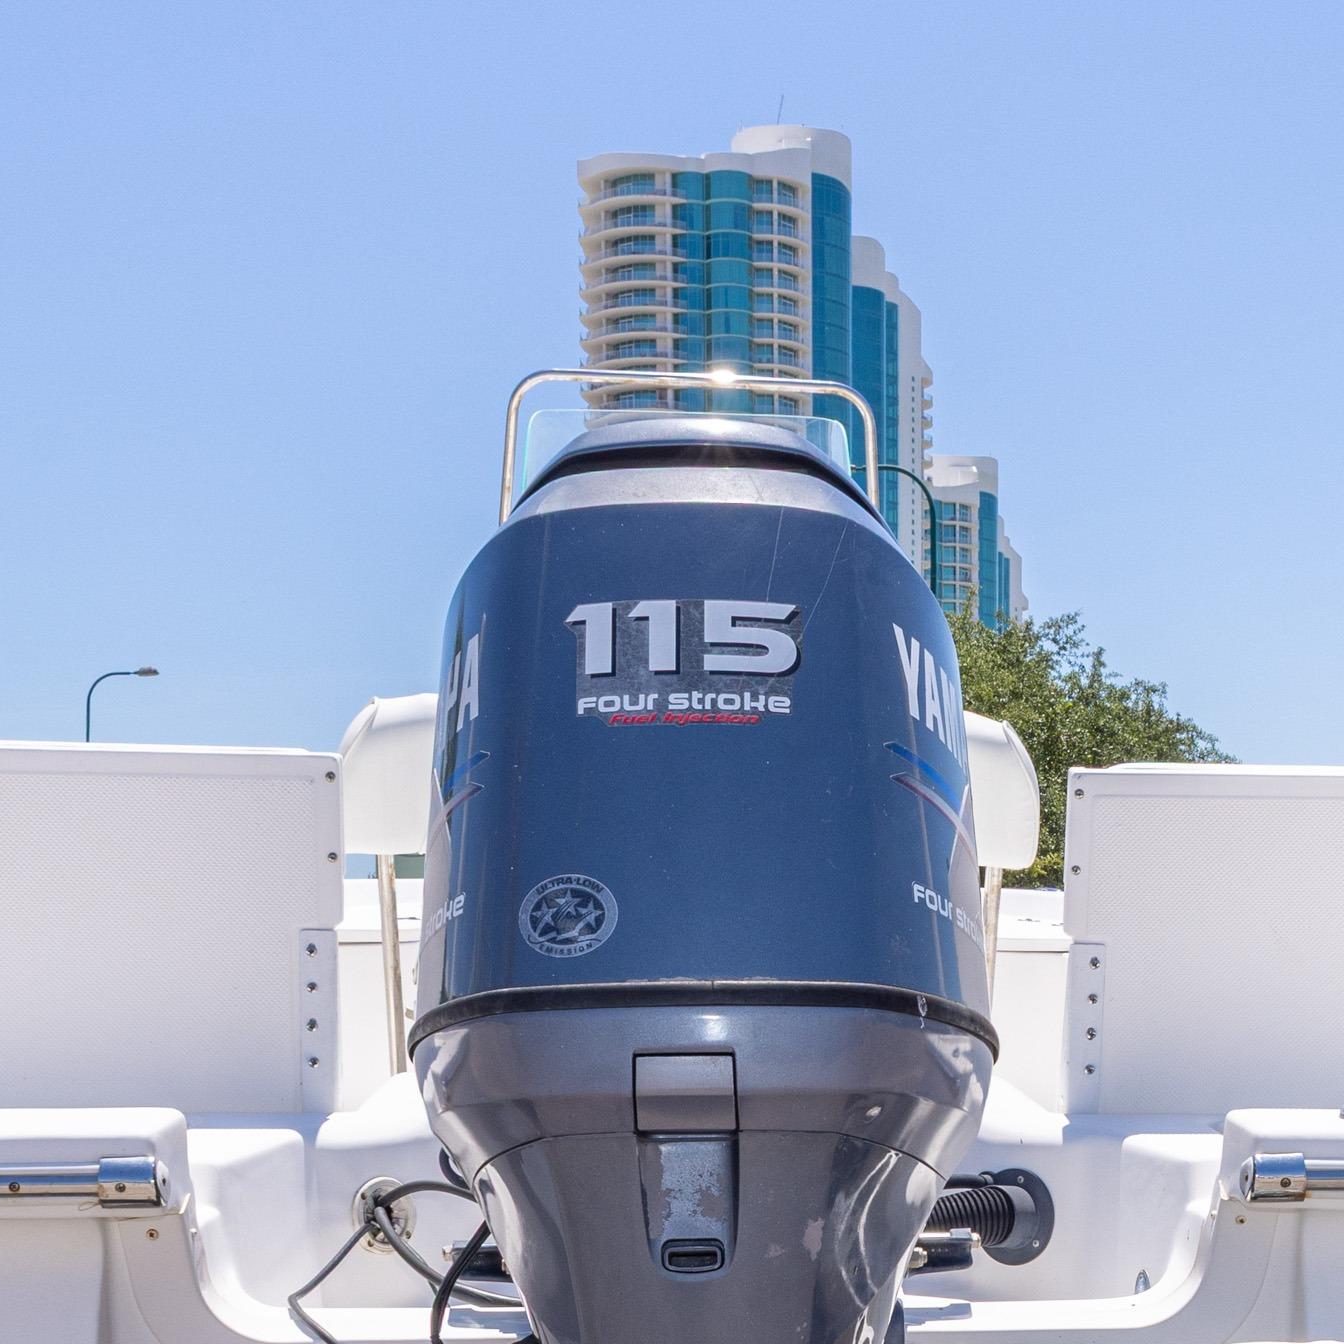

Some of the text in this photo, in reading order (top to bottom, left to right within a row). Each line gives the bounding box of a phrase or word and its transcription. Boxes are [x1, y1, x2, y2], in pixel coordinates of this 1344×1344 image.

[564, 599, 802, 676] 115
[607, 710, 760, 726] Fuel Injection
[893, 621, 967, 776] YAM
[538, 941, 593, 956] EMISSION
